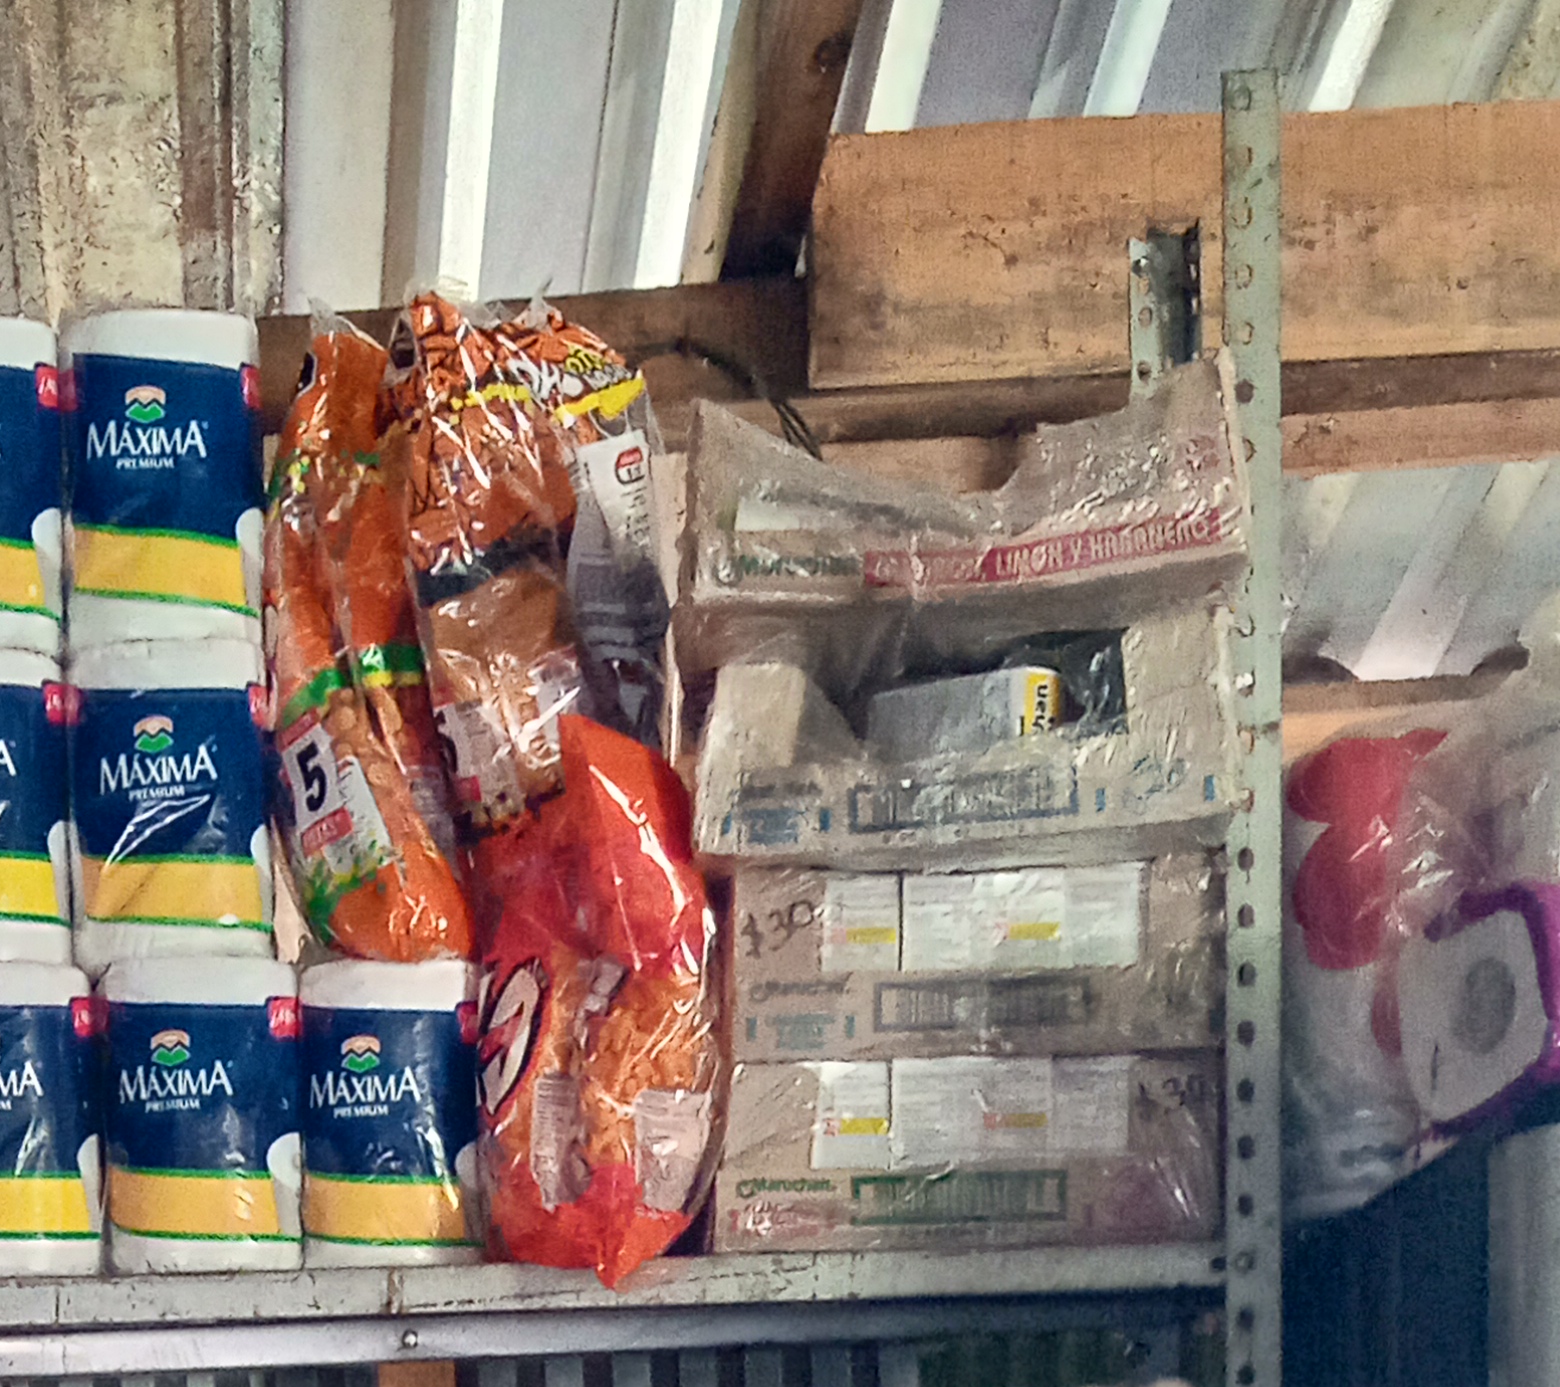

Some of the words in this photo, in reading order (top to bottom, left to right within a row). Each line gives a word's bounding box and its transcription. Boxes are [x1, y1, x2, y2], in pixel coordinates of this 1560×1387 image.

[87, 420, 208, 459] MÁXIMA
[100, 743, 218, 795] MÁXIMA
[296, 741, 327, 812] 5
[119, 1060, 233, 1104] MÁXIMA
[309, 1066, 421, 1109] MÁXIMA
